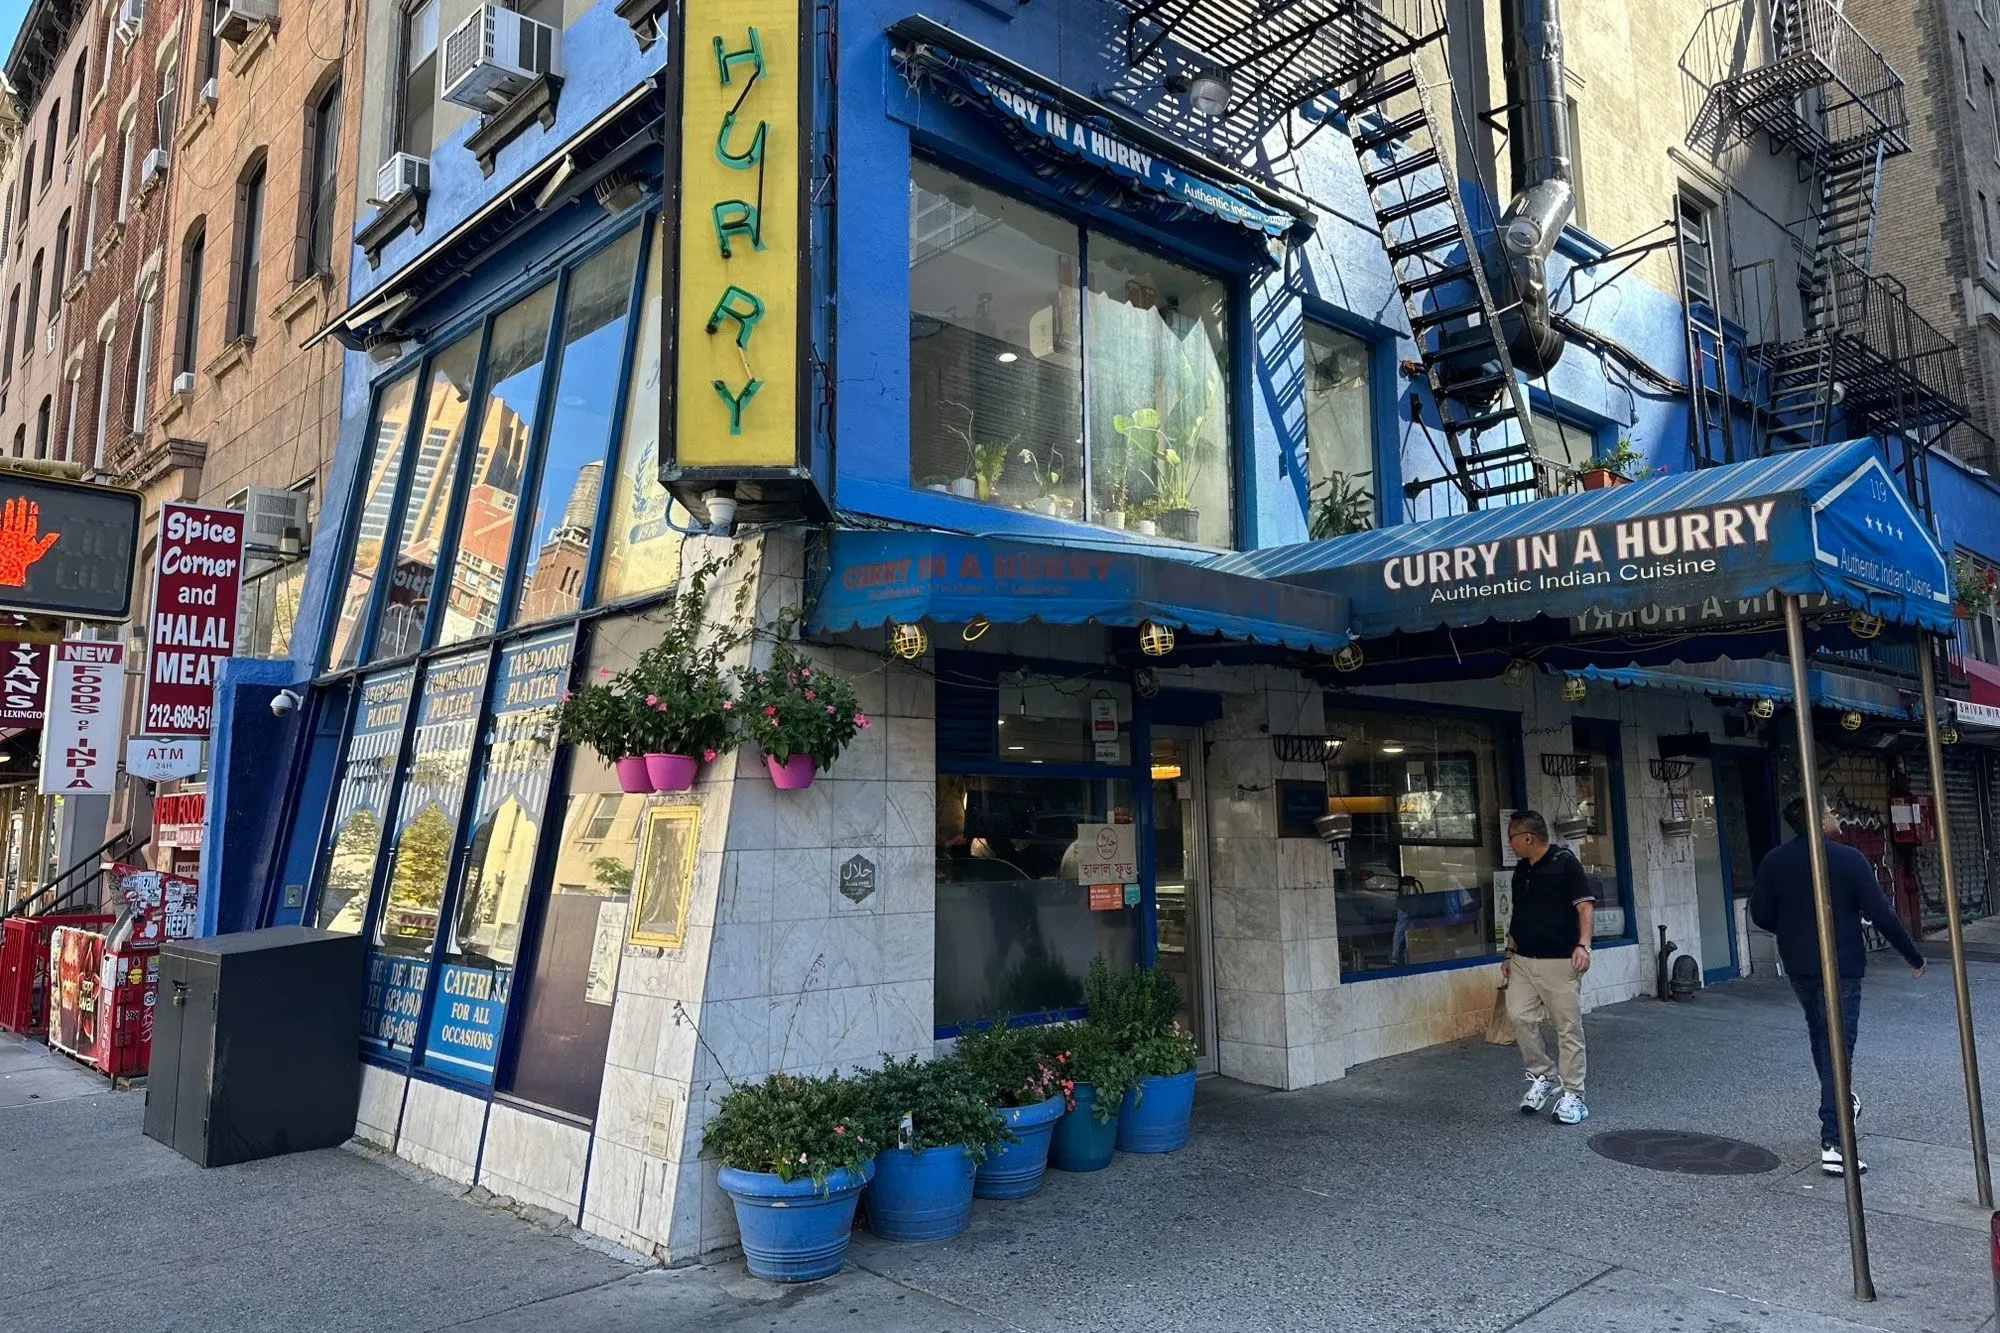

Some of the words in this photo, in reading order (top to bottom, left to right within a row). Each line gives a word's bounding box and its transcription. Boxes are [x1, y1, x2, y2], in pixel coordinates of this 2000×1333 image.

[1045, 109, 1068, 141] IN
[1072, 123, 1087, 150] A
[1091, 130, 1152, 178] HURRY
[1183, 181, 1230, 212] Authentic
[706, 25, 768, 436] HURRY
[167, 511, 236, 545] Spice
[161, 546, 237, 577] Corner
[1383, 541, 1500, 590] CURRY
[1516, 533, 1558, 571] IN
[1573, 528, 1603, 566] A
[1615, 501, 1776, 560] HURRY
[843, 559, 912, 590] CURRY
[918, 553, 947, 579] IN
[959, 554, 984, 580] A
[1430, 577, 1532, 604] Authentic
[1540, 569, 1611, 590] Indian
[1619, 558, 1717, 581] Cuisine
[1840, 547, 1880, 582] Authentic
[1881, 561, 1905, 589] Indian
[1905, 570, 1932, 599] Cuisine
[178, 583, 217, 606] and
[155, 612, 230, 650] HALAL
[64, 645, 114, 662] NEW
[507, 642, 571, 678] TANDOORI
[70, 665, 104, 715] FOODS
[506, 673, 560, 705] PLATTER
[78, 720, 89, 731] OF
[66, 738, 97, 789] INDIA
[146, 748, 184, 760] ATM
[842, 862, 872, 880] حلال
[443, 969, 510, 1004] CATERING
[450, 1002, 470, 1021] FOR
[472, 1006, 490, 1025] ALL
[441, 1024, 494, 1051] OCCASIONS
